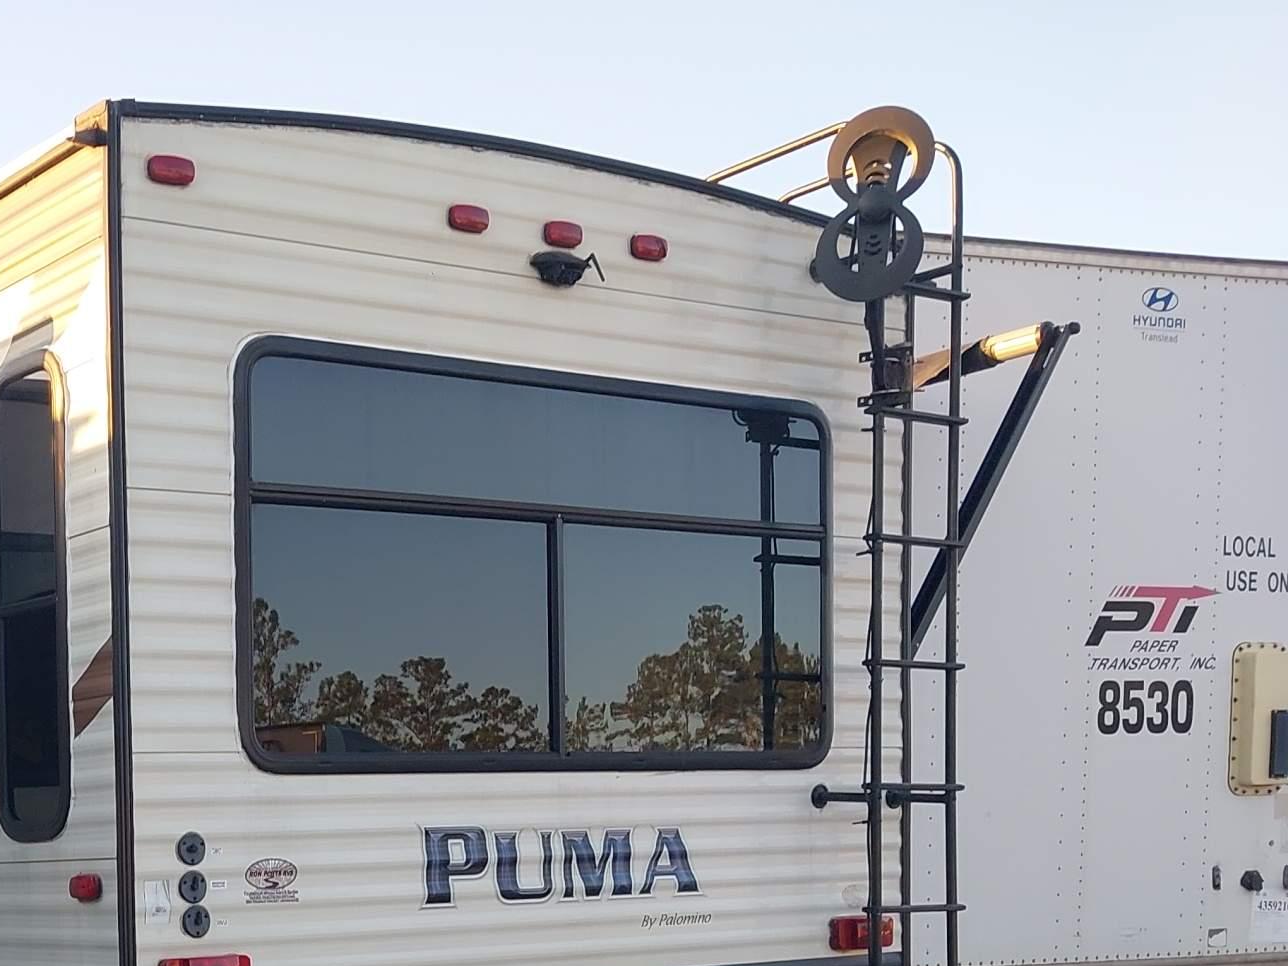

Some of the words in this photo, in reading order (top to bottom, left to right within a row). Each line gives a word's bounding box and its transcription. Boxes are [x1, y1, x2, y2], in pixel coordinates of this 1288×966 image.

[1133, 315, 1186, 329] HYUNDAI
[1141, 332, 1178, 344] Translead
[1223, 536, 1276, 558] LOCAL
[1226, 571, 1258, 591] USE
[1130, 640, 1179, 653] PAPER
[1090, 657, 1181, 671] TRANSPORT,
[1190, 657, 1216, 670] INC.
[1097, 680, 1194, 735] 8530
[419, 824, 705, 909] PUMA
[1257, 900, 1288, 911] 435921
[641, 914, 657, 929] By
[659, 912, 711, 926] Palomino
